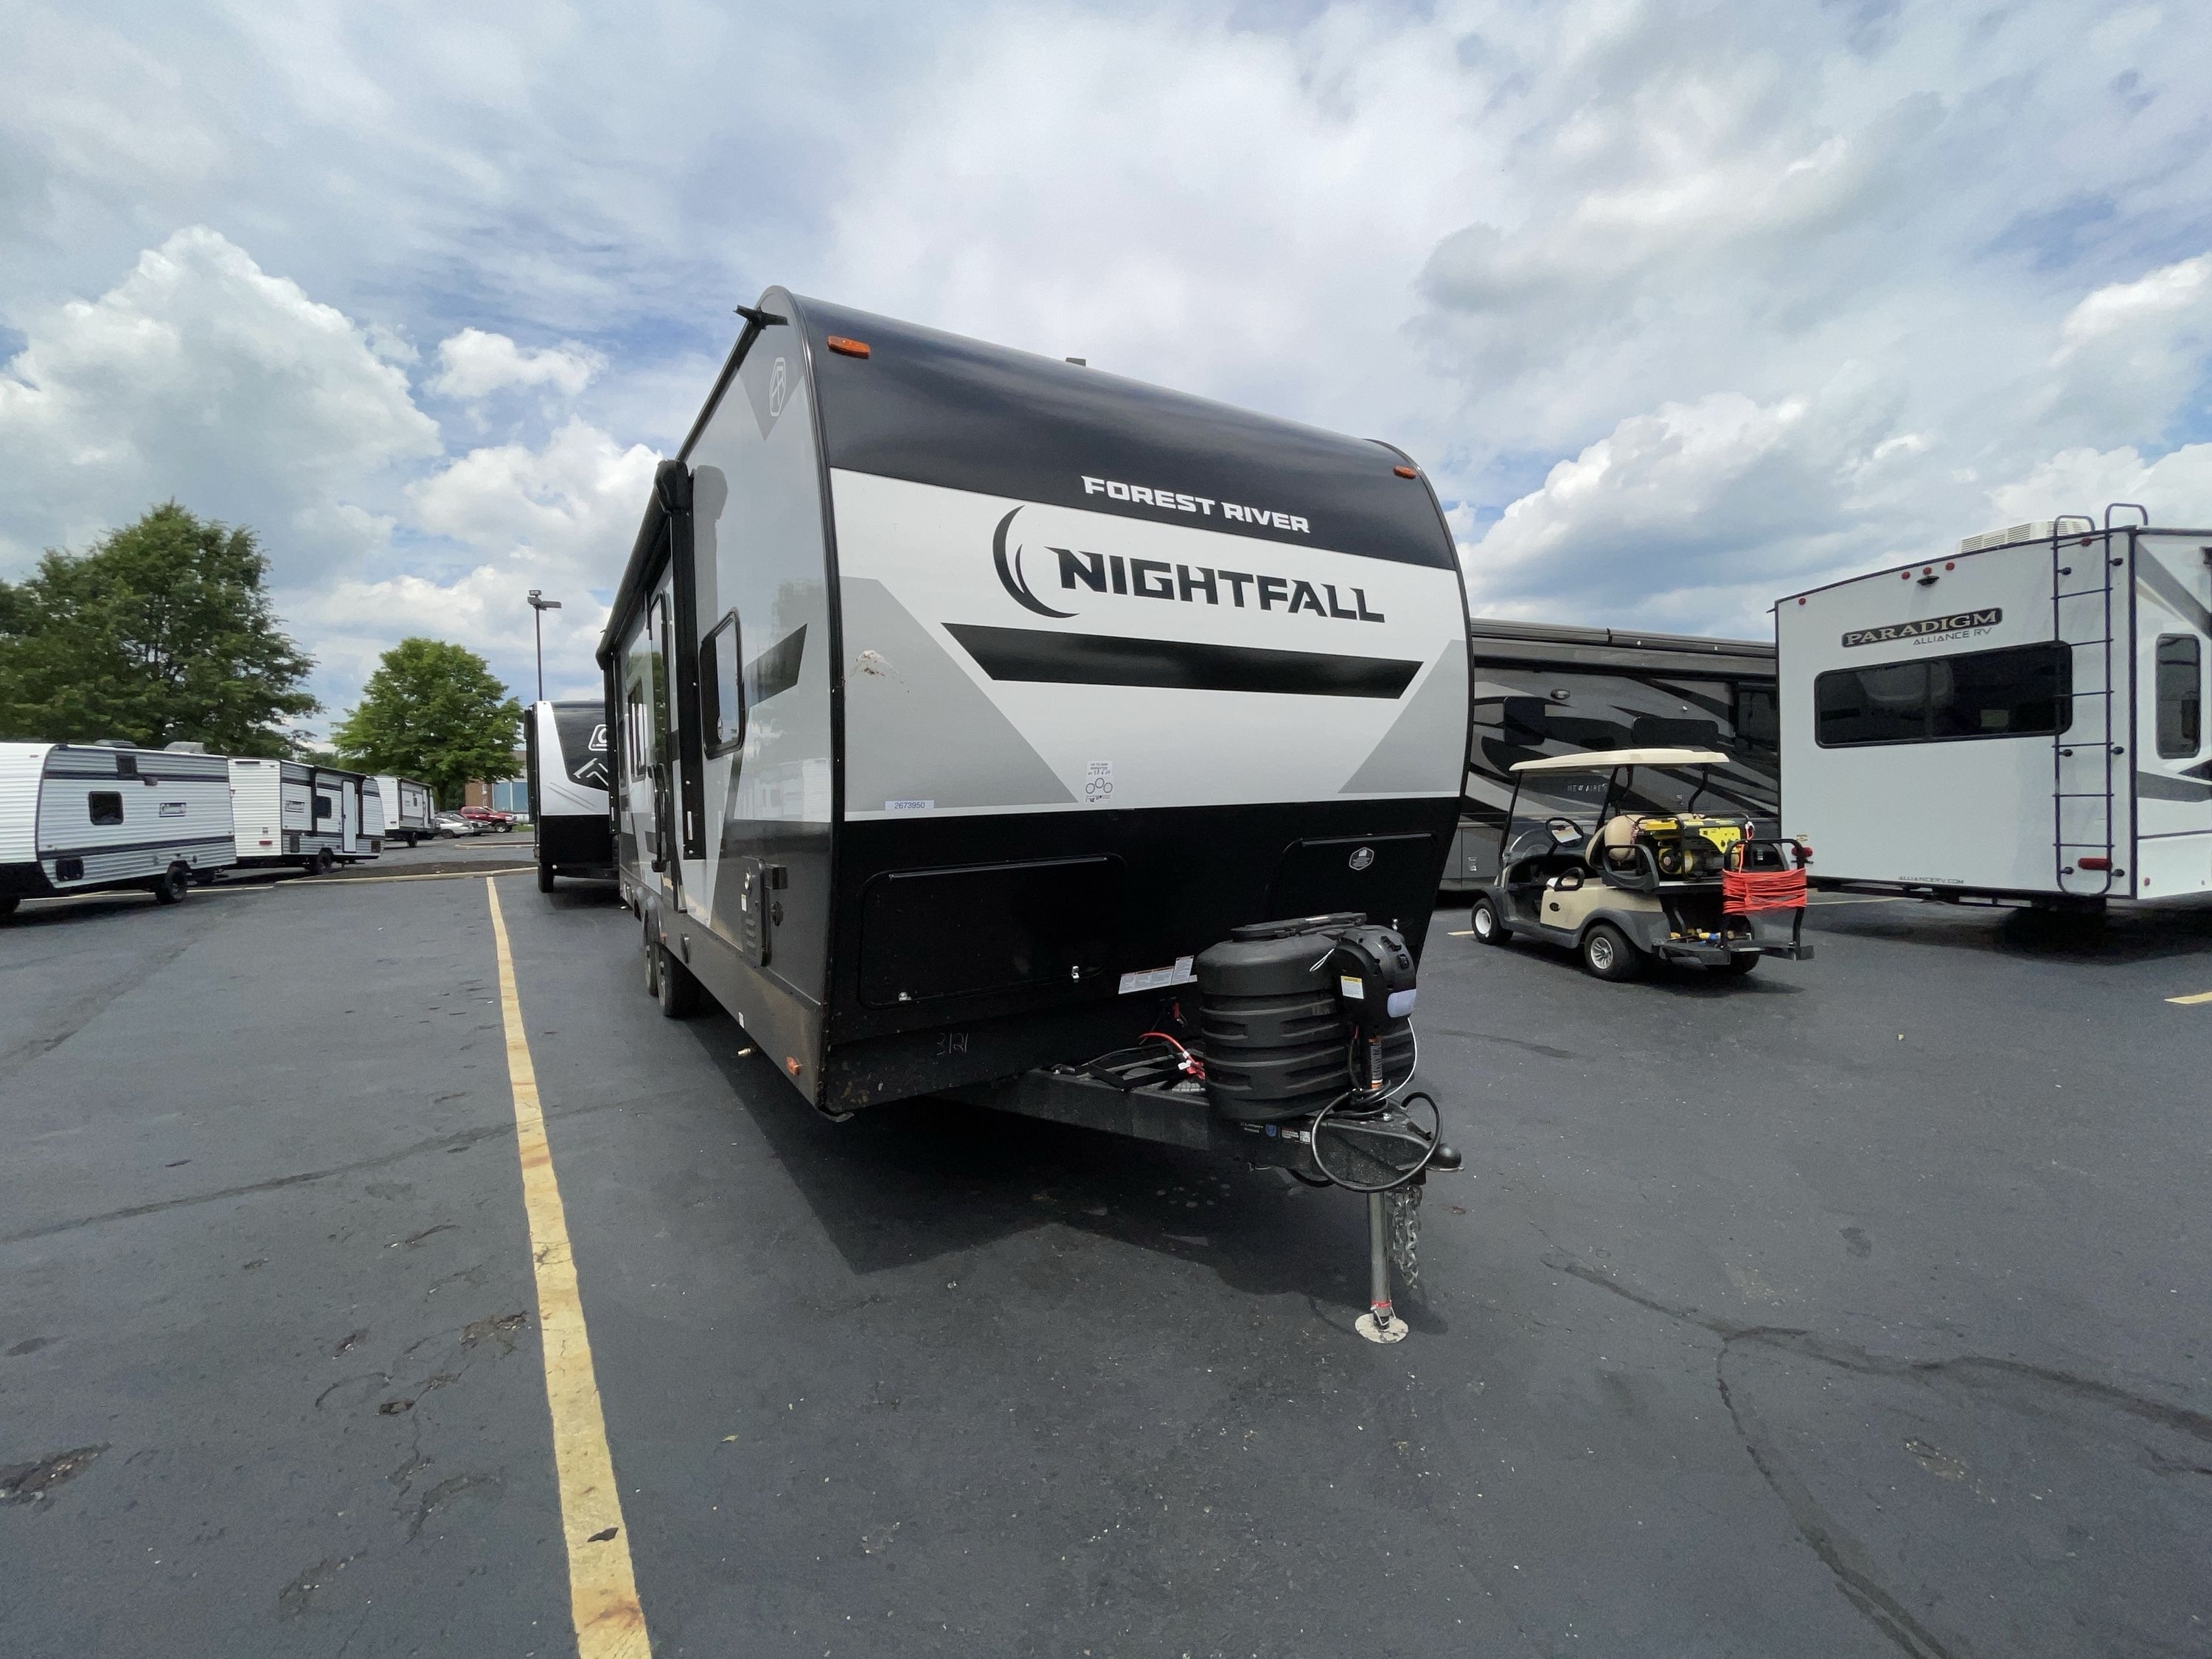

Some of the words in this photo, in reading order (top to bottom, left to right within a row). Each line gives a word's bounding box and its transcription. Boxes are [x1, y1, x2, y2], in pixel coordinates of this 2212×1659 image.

[1081, 476, 1215, 515] FOREST
[1220, 501, 1310, 534] RIVER
[1043, 546, 1385, 624] NIGHTFALL
[1845, 610, 1998, 646] PARADIGM
[1913, 630, 1969, 646] ALLIANCE
[1974, 627, 1992, 636] RV
[894, 801, 925, 810] 2673950
